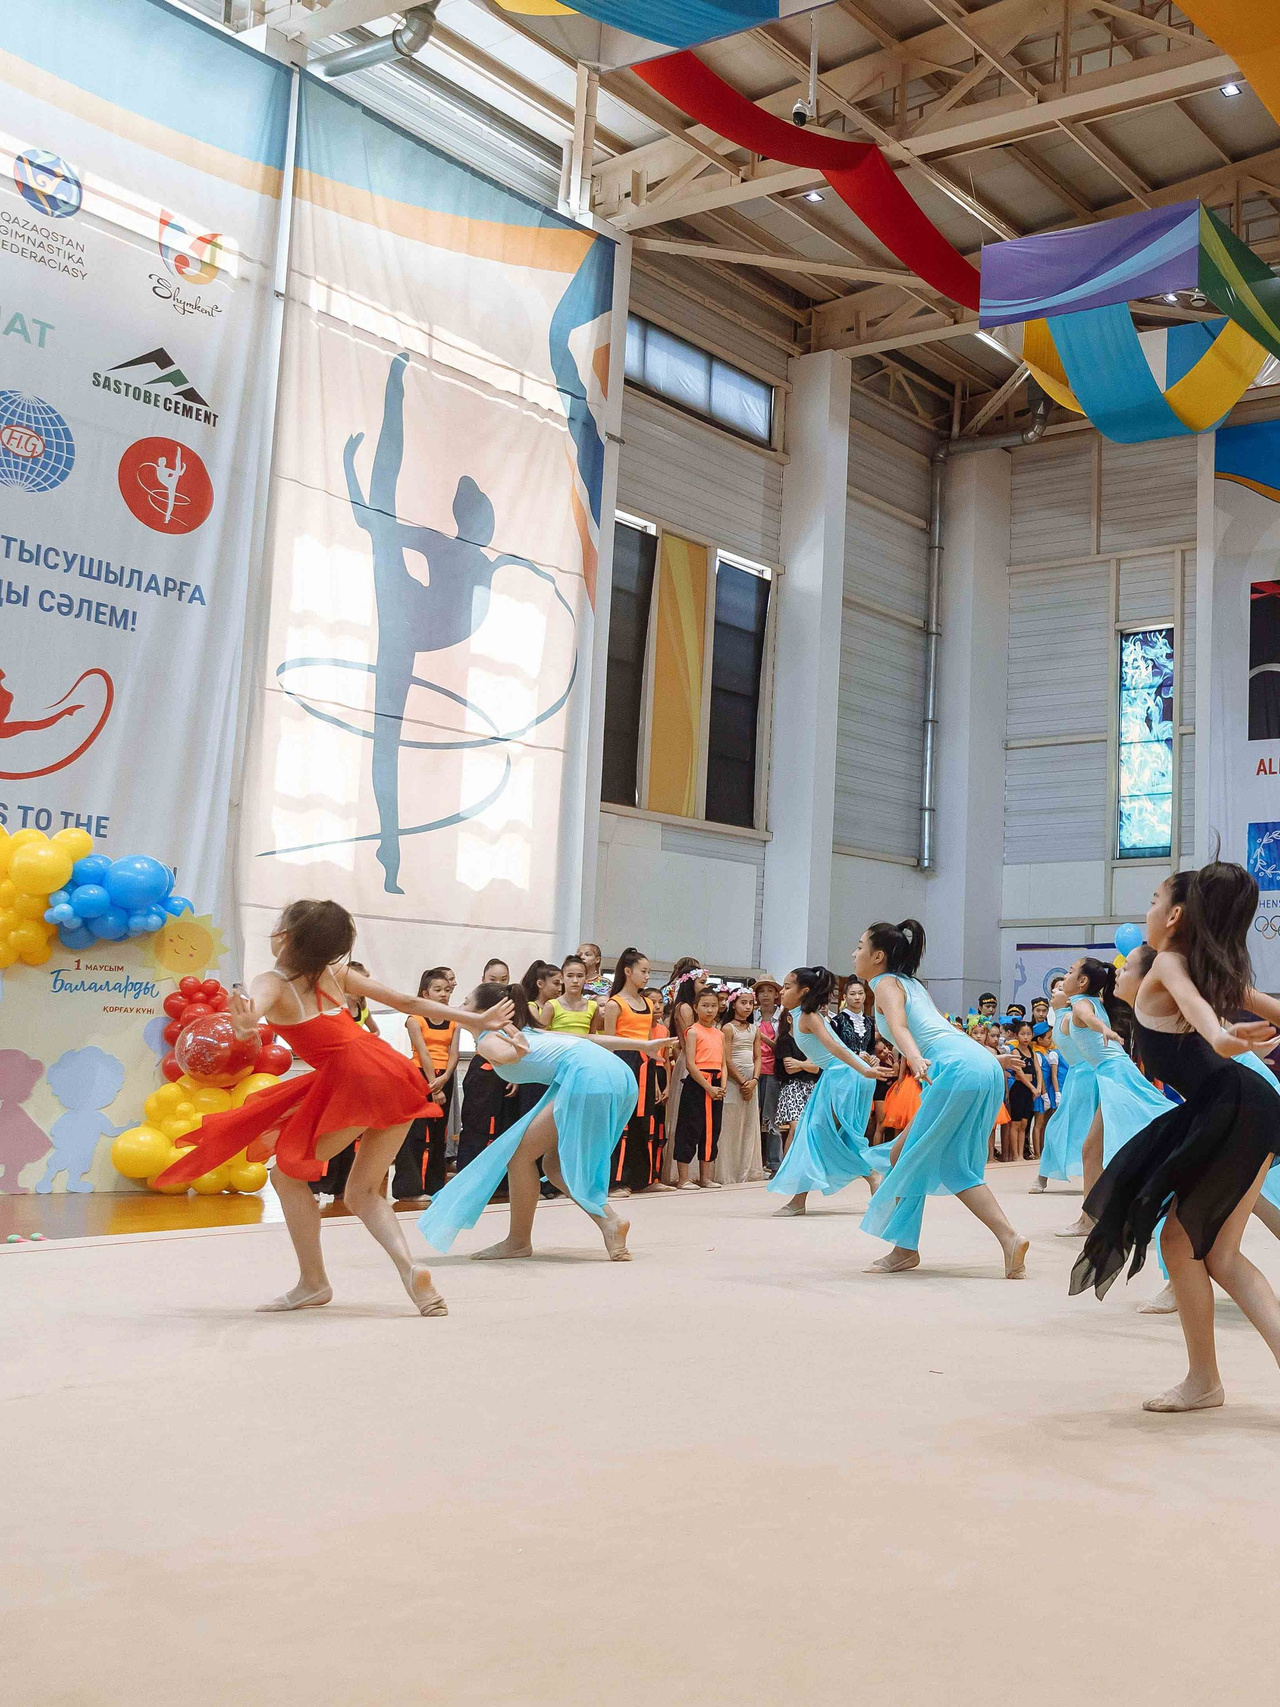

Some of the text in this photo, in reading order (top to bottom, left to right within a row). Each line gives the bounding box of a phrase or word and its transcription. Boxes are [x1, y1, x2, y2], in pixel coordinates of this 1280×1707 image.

[0, 224, 85, 267] GIMNASTIKA
[1, 211, 86, 253] QAZAQSTAN
[0, 239, 88, 281] EDERACIASY
[148, 273, 223, 318] Shymkent
[2, 311, 56, 349] AT
[92, 371, 219, 428] SASTOBE CEMENT
[38, 589, 139, 633] СӘЛЕМ!
[17, 805, 53, 831] TO
[60, 810, 110, 838] THE
[50, 968, 159, 1000] Балаларды
[74, 959, 124, 972] 1 МАУСЫМ
